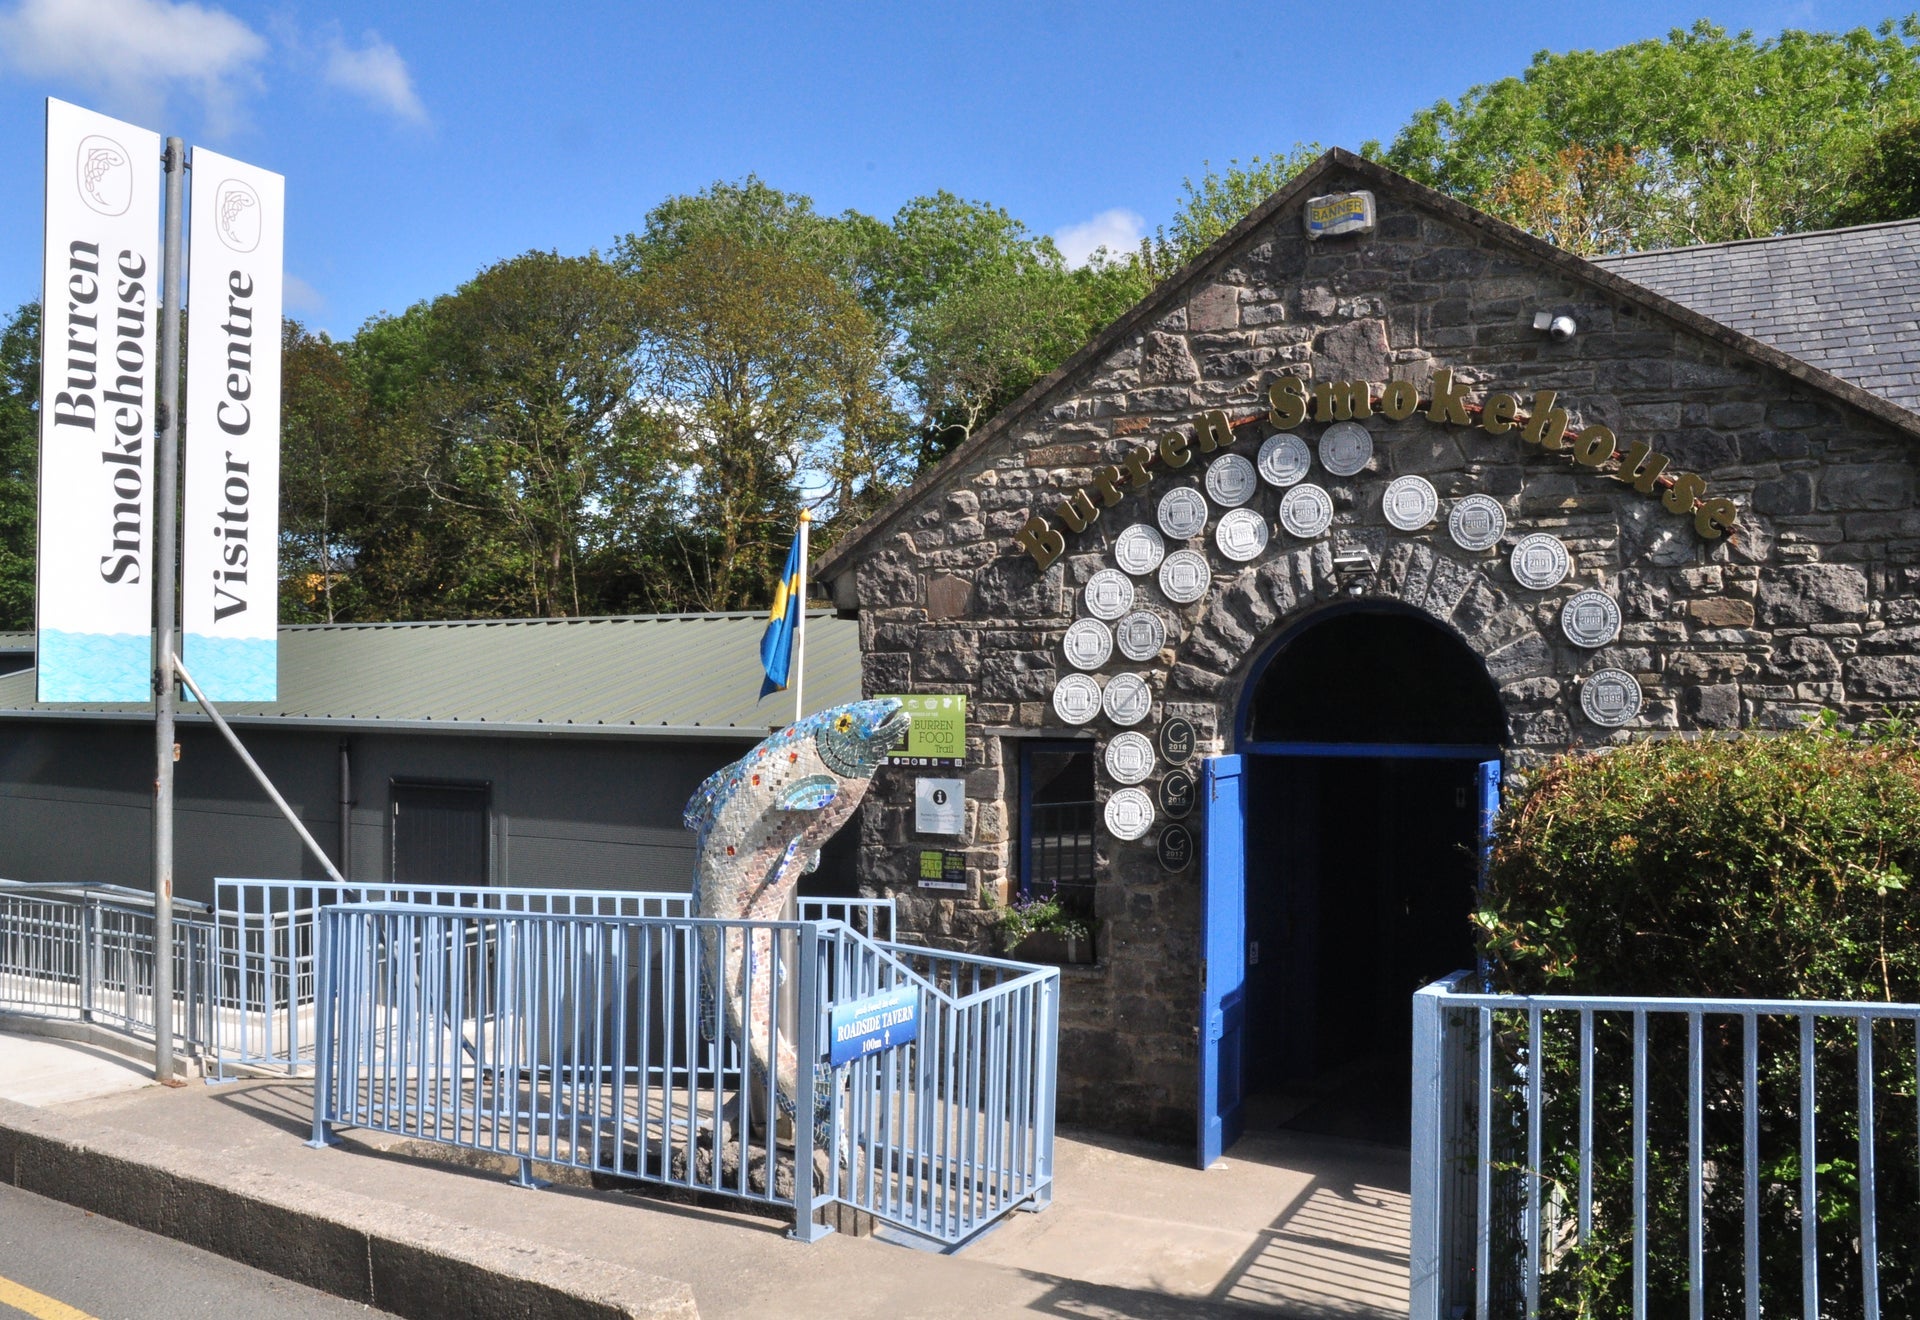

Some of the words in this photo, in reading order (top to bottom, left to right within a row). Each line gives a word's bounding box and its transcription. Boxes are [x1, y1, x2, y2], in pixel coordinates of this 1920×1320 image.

[1312, 200, 1362, 221] BANNER
[55, 240, 100, 433] Burren
[217, 270, 254, 436] Centre
[100, 249, 146, 585] Smokehouse
[1014, 409, 1237, 572] Burren
[1268, 366, 1736, 539] Smokehouse
[1288, 487, 1330, 514] BRIDGESTONE
[1392, 479, 1435, 505] BRIDGESTONE
[1458, 497, 1503, 527] BRIDGESTONE
[213, 450, 250, 625] Visitor
[1521, 536, 1566, 566] BRIDGESTONE
[1168, 553, 1207, 581] BRIDGESTONE
[1529, 559, 1550, 567] 2001
[1572, 593, 1617, 624] BRIDGESTONE
[1580, 616, 1600, 625] 2000
[1125, 612, 1163, 640] BRIDGESTONE
[1590, 671, 1638, 702] BRIDGESTONE
[1600, 695, 1621, 703] 1999
[914, 720, 953, 730] BURREN
[919, 731, 954, 743] FOOD
[935, 744, 954, 753] Trail
[1113, 735, 1152, 762] BRIDGESTONE
[837, 1015, 880, 1042] ROADSIDE
[882, 1005, 914, 1028] TAVERN
[863, 1038, 882, 1052] 100m
